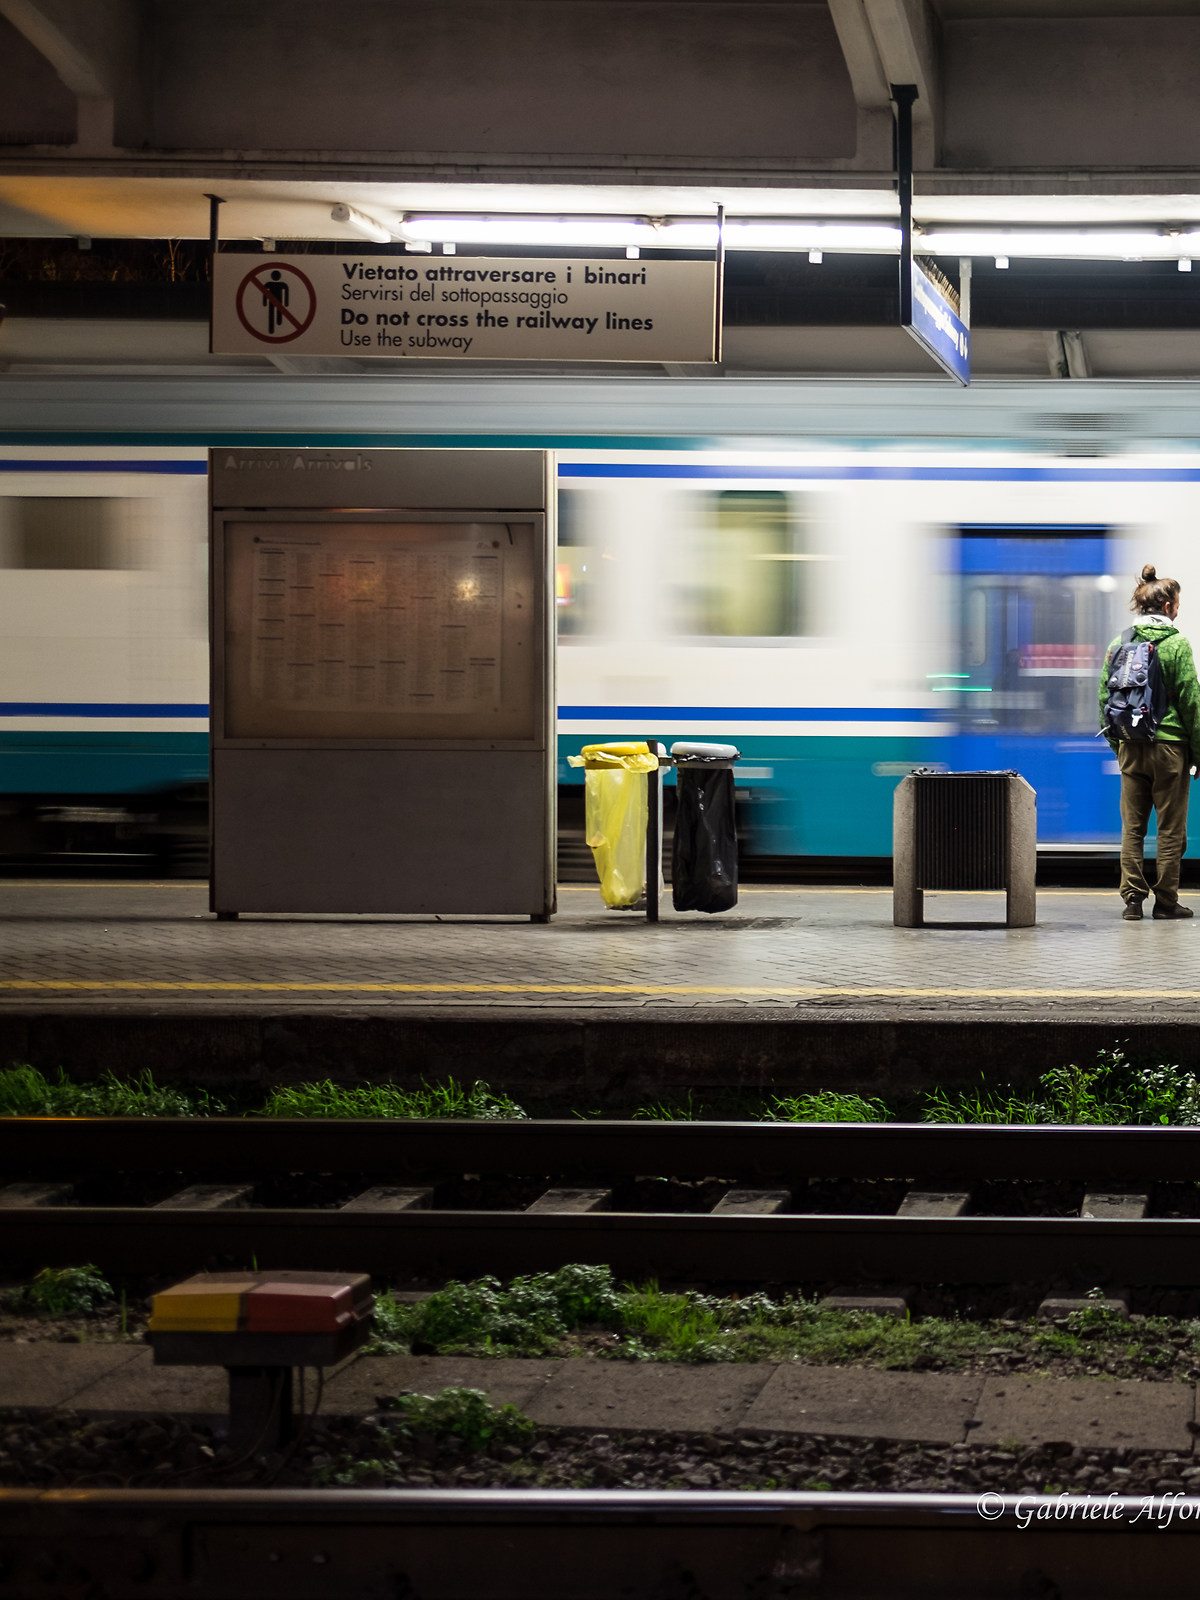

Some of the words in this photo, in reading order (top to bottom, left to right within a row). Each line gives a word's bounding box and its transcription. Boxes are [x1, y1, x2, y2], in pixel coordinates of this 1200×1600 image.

[342, 262, 420, 283] Vietato
[425, 265, 556, 285] attraversare
[566, 266, 572, 284] i
[584, 265, 646, 286] binari
[341, 283, 403, 302] Servirsi
[409, 284, 435, 303] del
[441, 285, 568, 309] sottopassaggio
[340, 308, 369, 327] Do
[376, 310, 411, 329] not
[416, 313, 469, 330] cross
[476, 310, 509, 330] the
[516, 309, 599, 334] railway
[606, 310, 654, 332] lines
[340, 329, 371, 347] Use
[377, 329, 402, 347] the
[408, 330, 473, 353] subway
